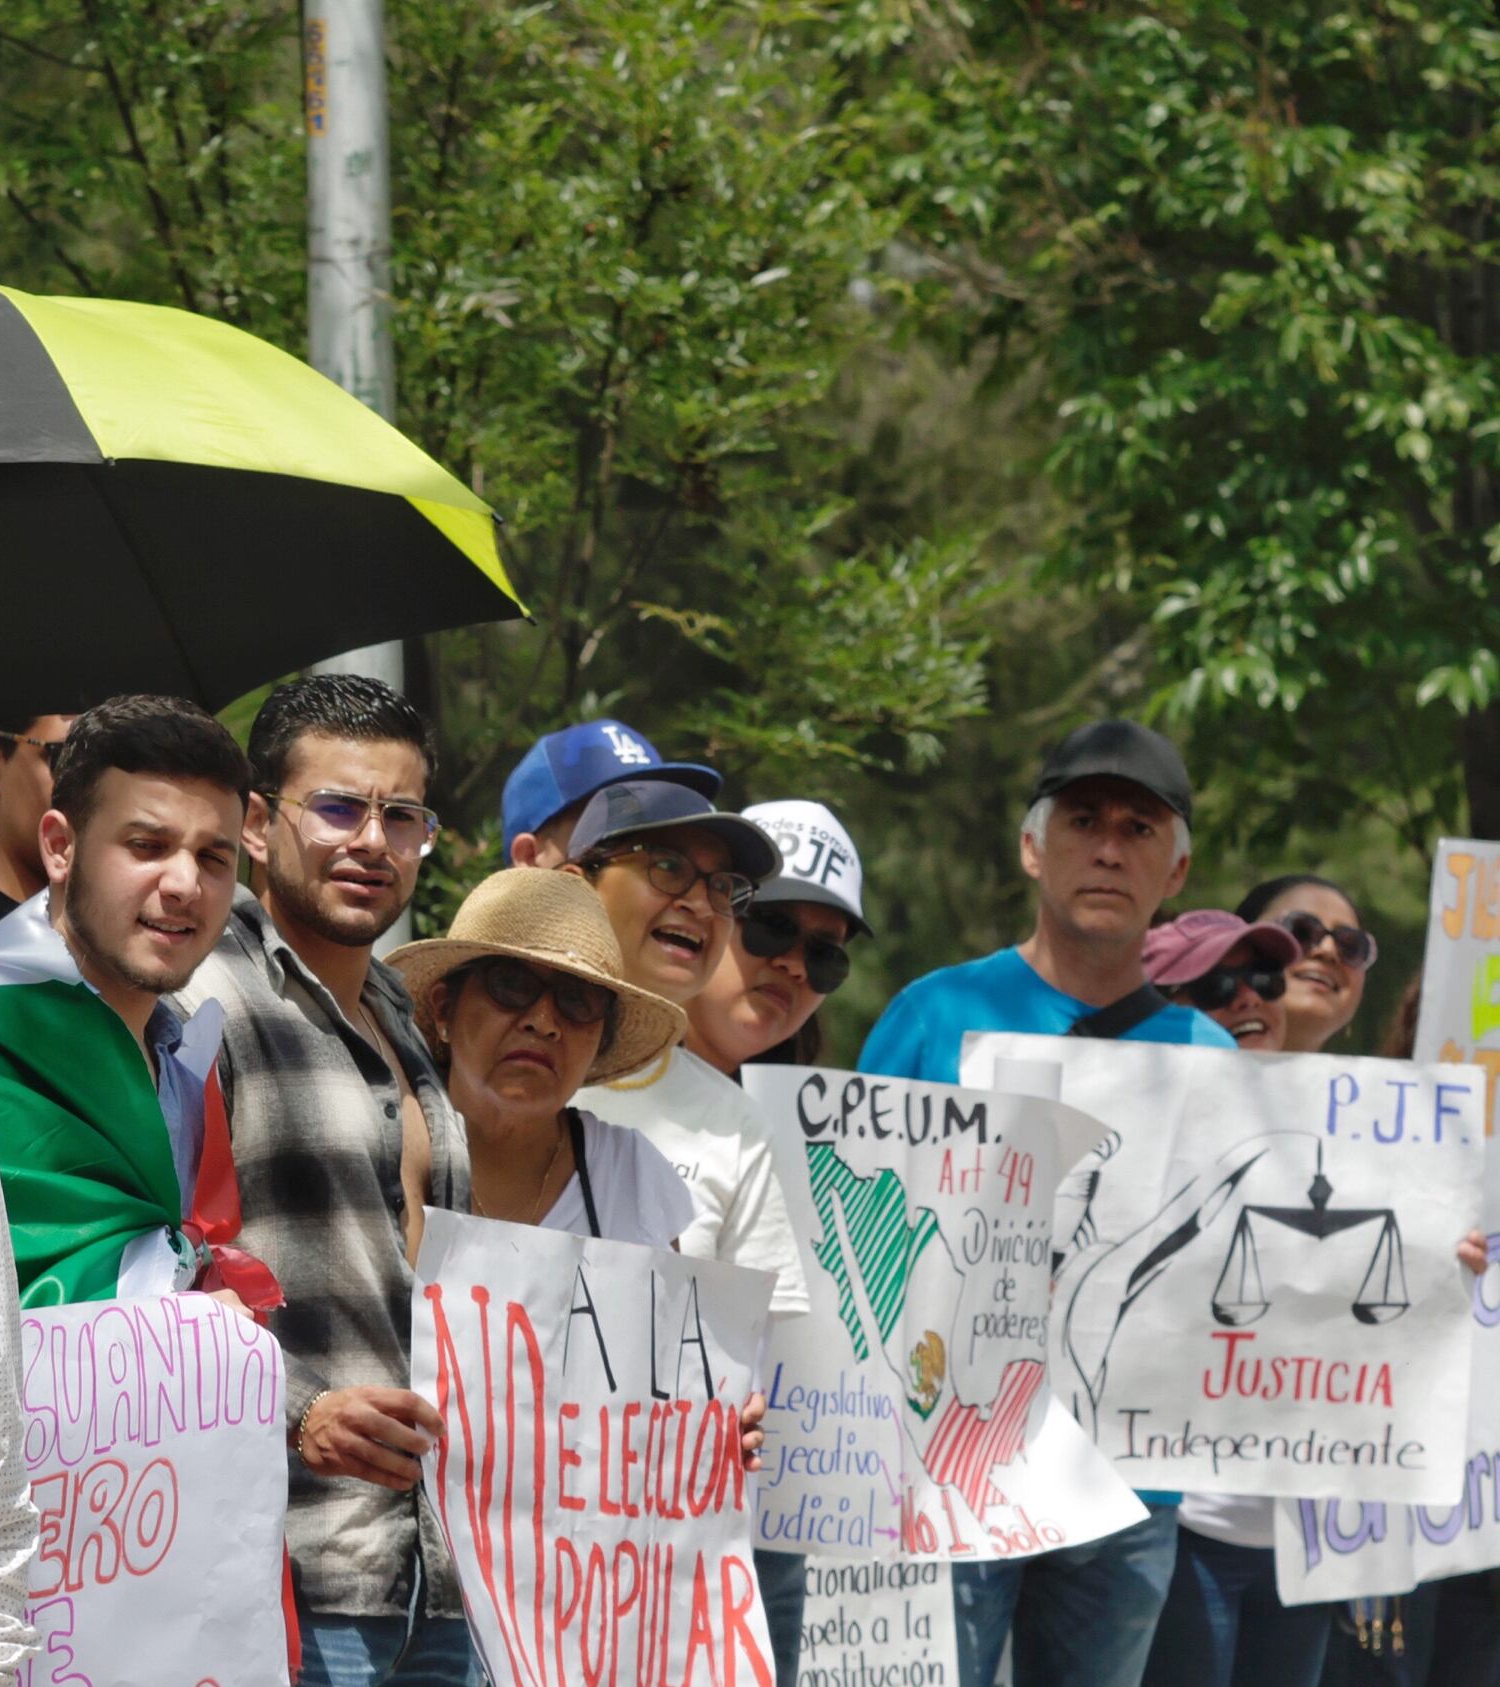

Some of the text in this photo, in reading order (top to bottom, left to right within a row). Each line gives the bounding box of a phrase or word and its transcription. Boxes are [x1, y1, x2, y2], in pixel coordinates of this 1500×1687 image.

[601, 726, 651, 764] LA
[1327, 1074, 1472, 1144] P.J.F.
[938, 1148, 986, 1196] Art
[993, 1267, 1016, 1302] de
[562, 1265, 617, 1393] A
[969, 1304, 1049, 1367] poderes
[768, 1362, 894, 1432] Legislativo
[1113, 1408, 1427, 1475] Independiente
[554, 1536, 778, 1687] POPULAR
[872, 1617, 889, 1644] a
[905, 1601, 932, 1640] la
